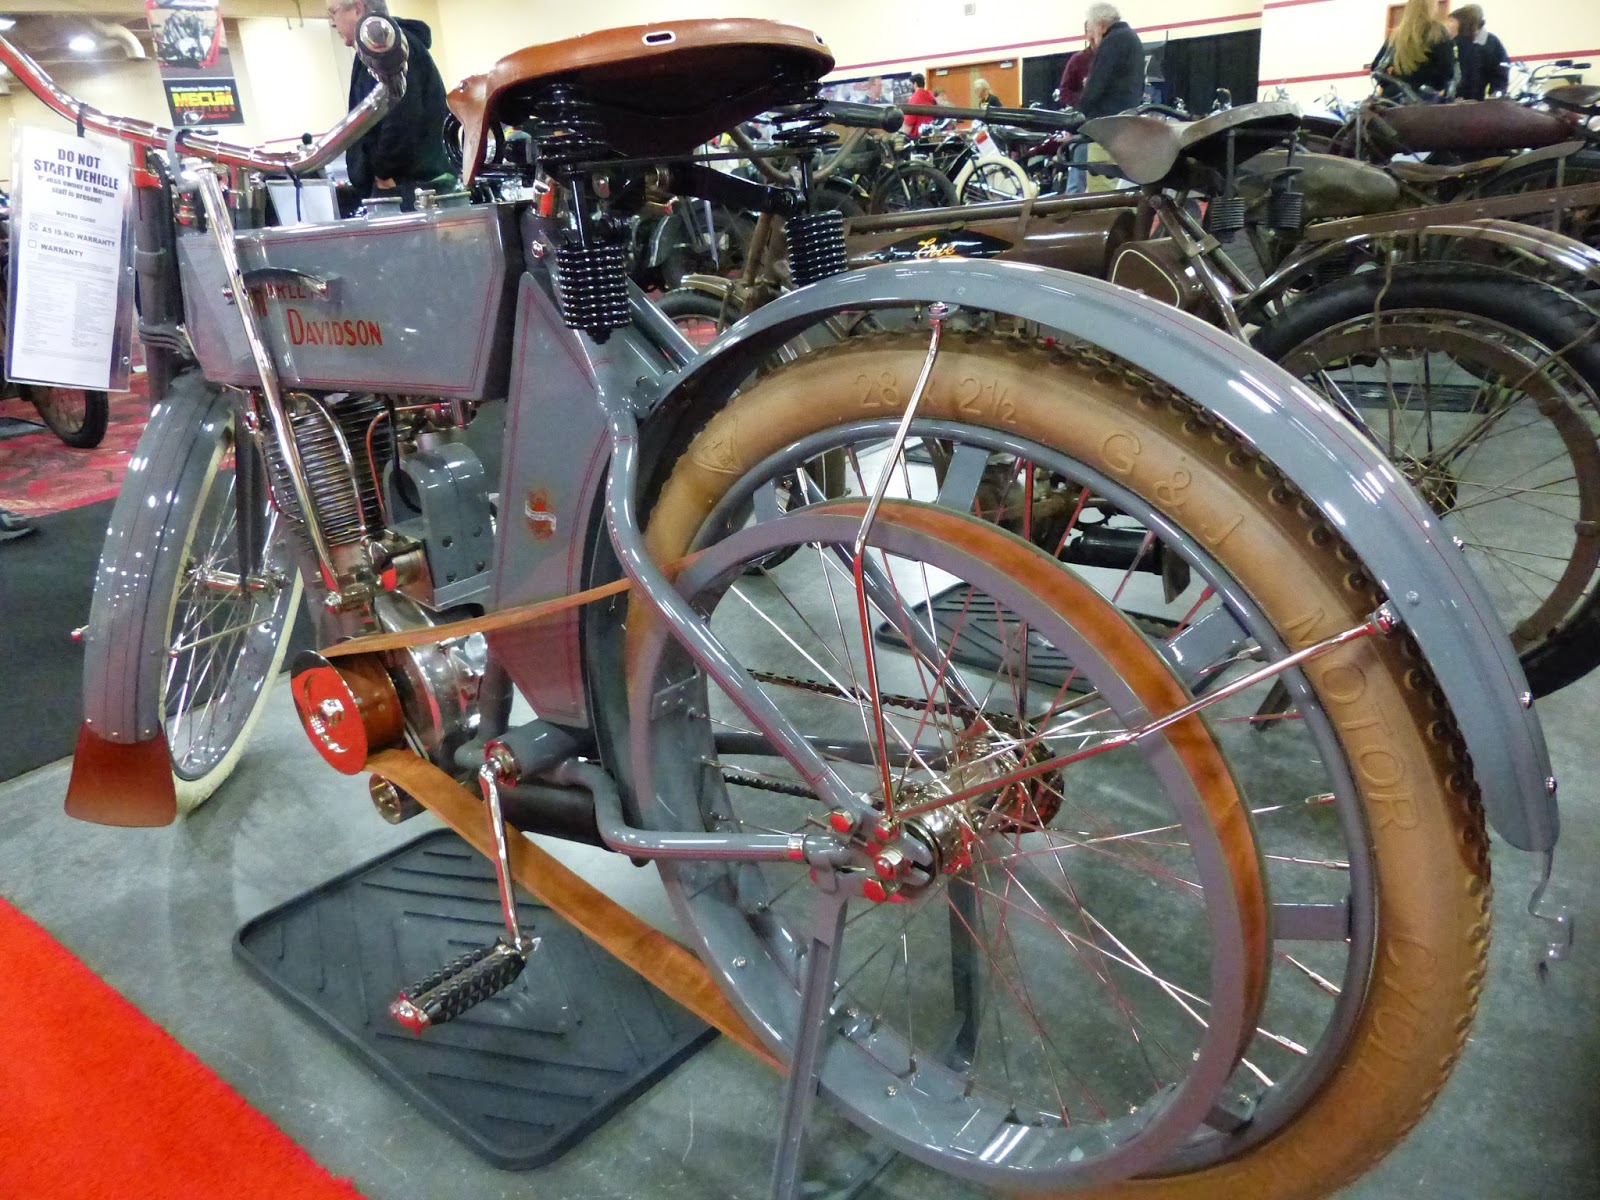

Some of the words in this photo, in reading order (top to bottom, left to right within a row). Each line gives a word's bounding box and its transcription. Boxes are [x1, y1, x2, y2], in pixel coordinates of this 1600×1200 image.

[173, 91, 234, 107] MECUM
[58, 148, 75, 162] DO
[78, 153, 101, 169] NOT
[33, 158, 73, 178] START
[75, 167, 119, 190] VEHICLE
[42, 226, 52, 234] AS
[77, 233, 116, 247] WARRANTY
[41, 244, 84, 257] WARRANTY
[853, 372, 901, 409] 28
[1101, 429, 1142, 476] G
[1151, 465, 1193, 508] &
